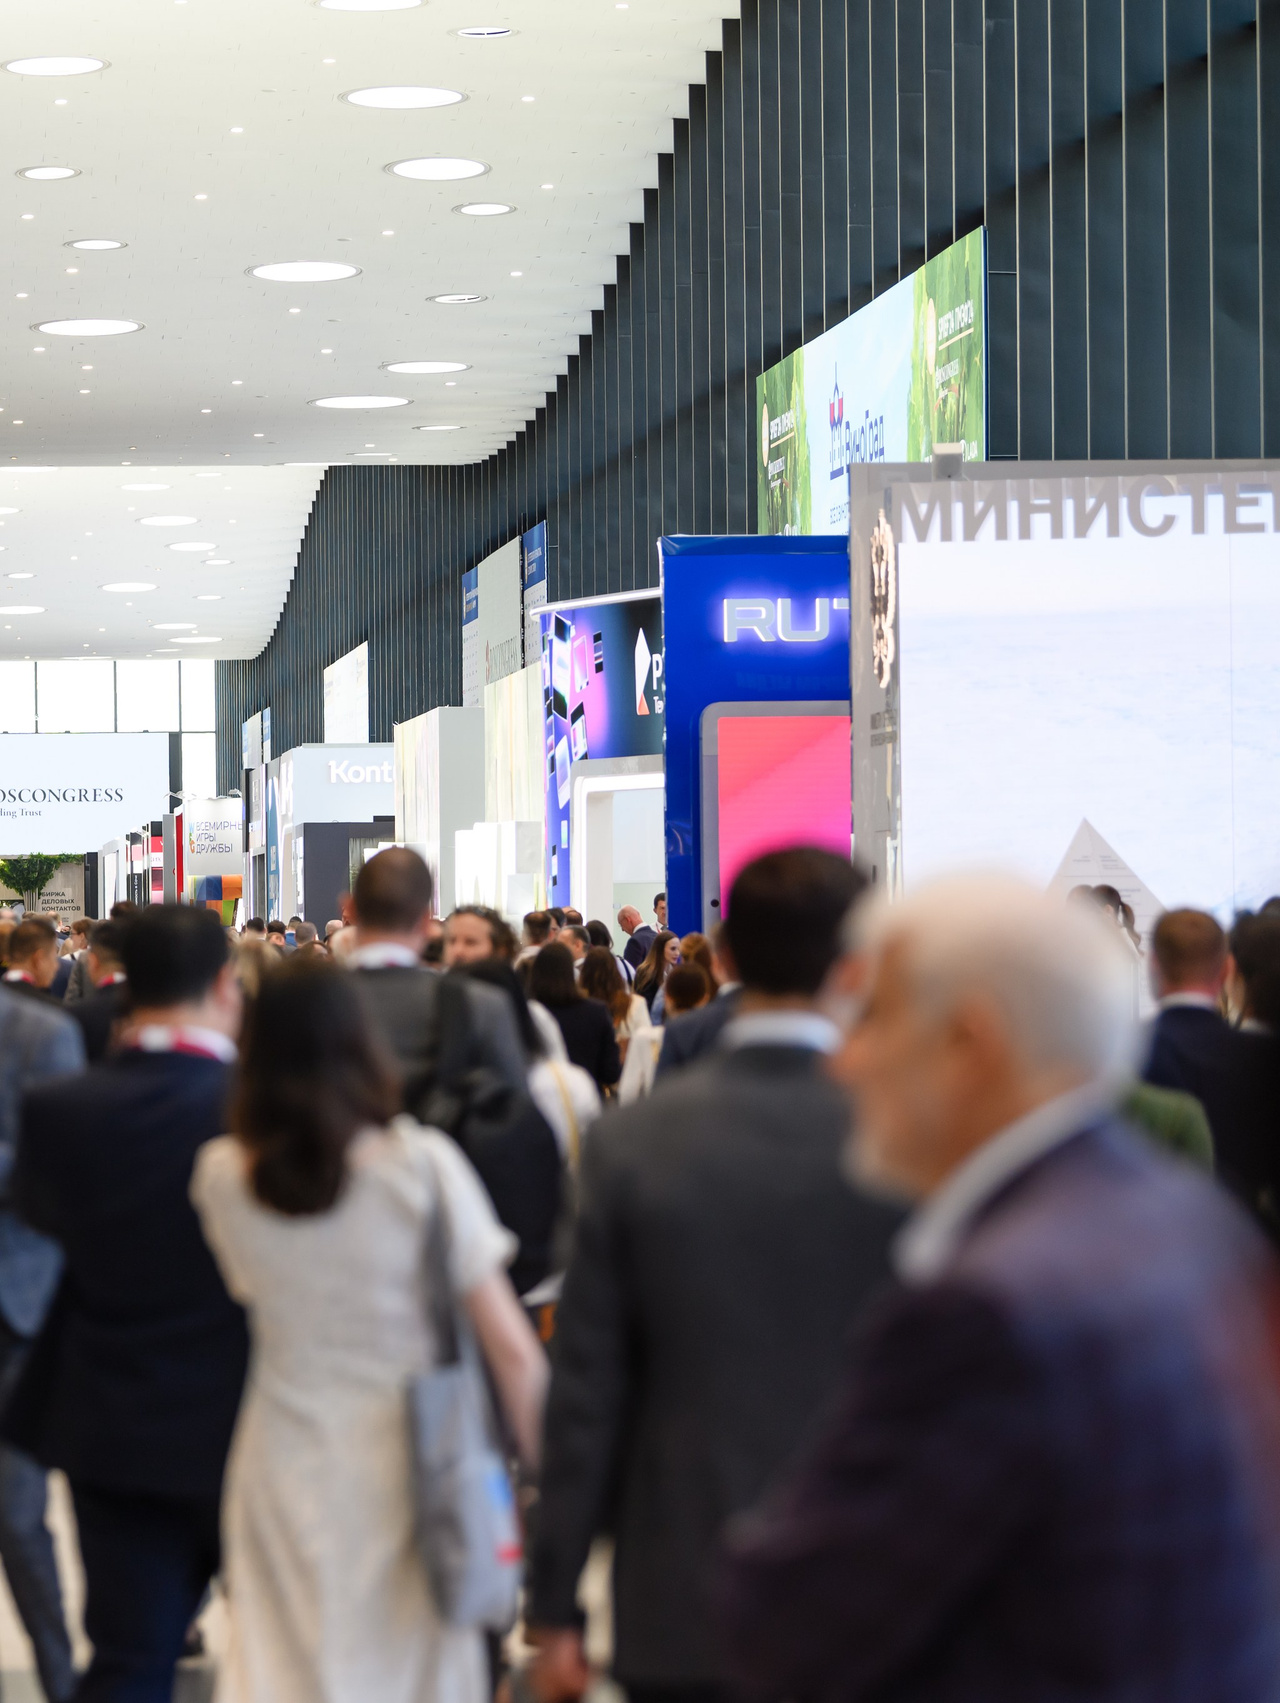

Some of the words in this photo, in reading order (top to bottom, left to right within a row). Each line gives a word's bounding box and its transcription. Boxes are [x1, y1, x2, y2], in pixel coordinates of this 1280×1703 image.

[892, 474, 1280, 543] МИНИСТЕ
[328, 760, 395, 784] Kont
[19, 808, 42, 817] Trust
[196, 832, 217, 842] ИГРЫ
[196, 843, 233, 855] ДРУЖБЫ
